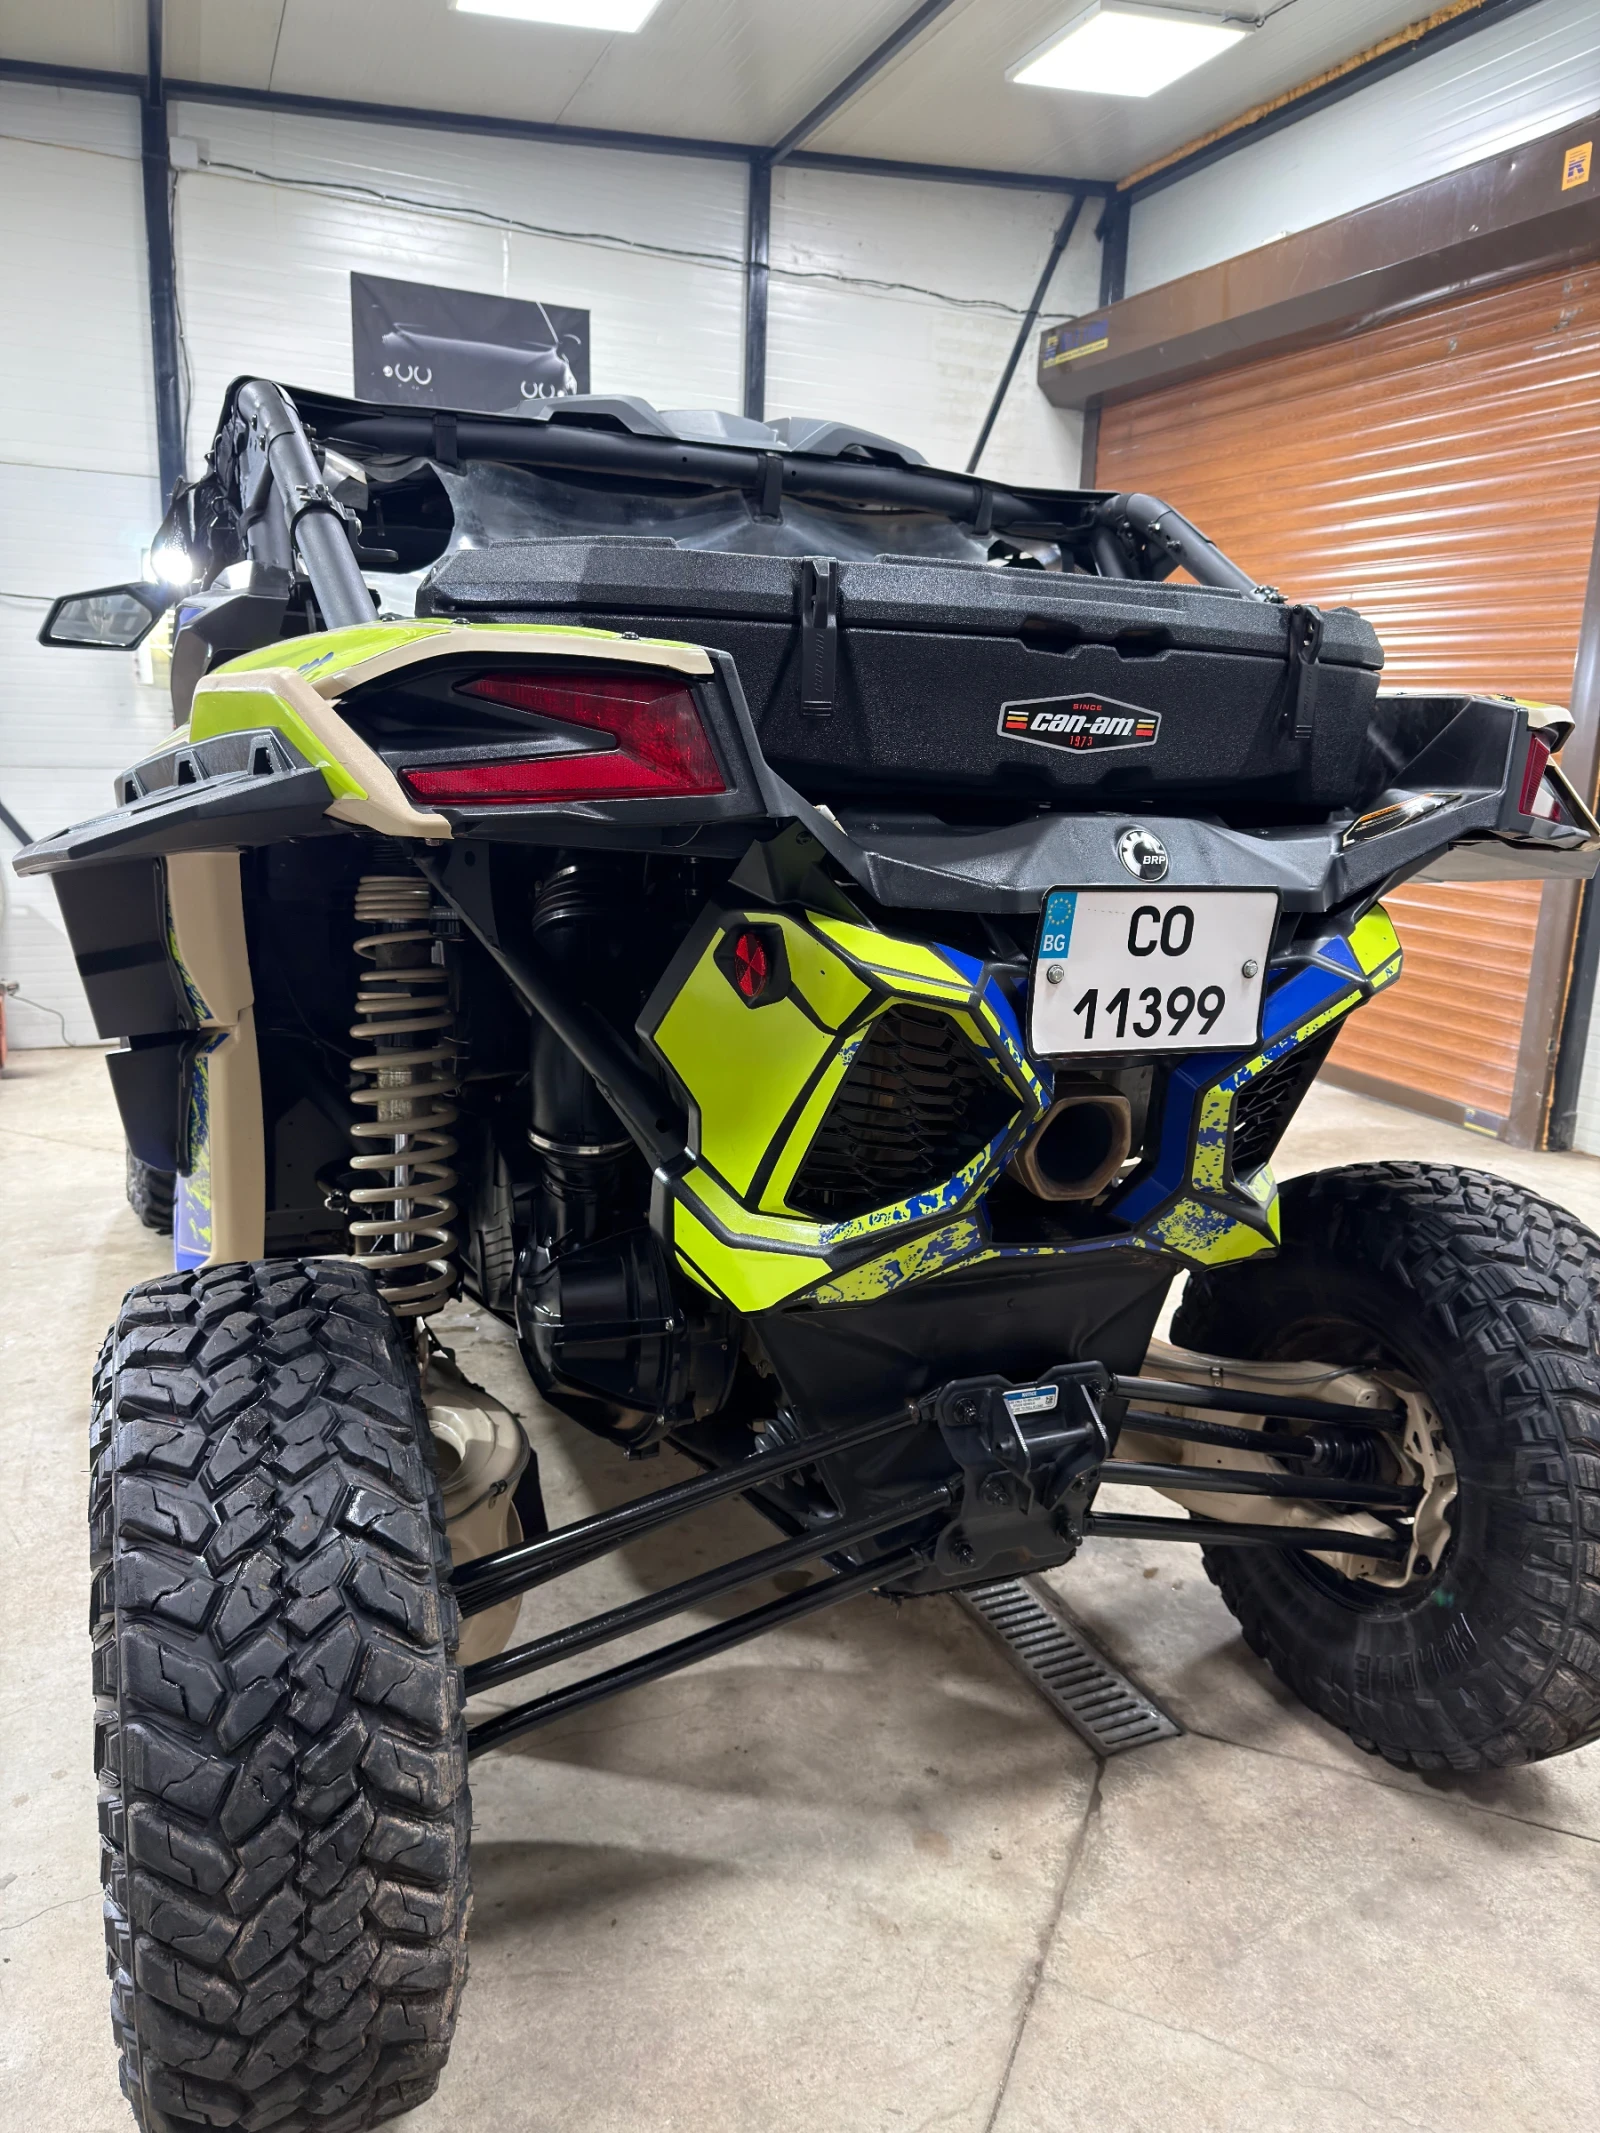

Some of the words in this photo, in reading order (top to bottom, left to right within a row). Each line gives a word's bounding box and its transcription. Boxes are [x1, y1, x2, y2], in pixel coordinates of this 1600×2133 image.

[1072, 703, 1102, 711] SINCE
[1030, 712, 1135, 736] can-am
[1069, 735, 1093, 747] 1973
[1142, 855, 1167, 865] BRP
[1127, 905, 1195, 957] CO
[1042, 934, 1066, 952] BG
[1072, 985, 1226, 1040] 11399
